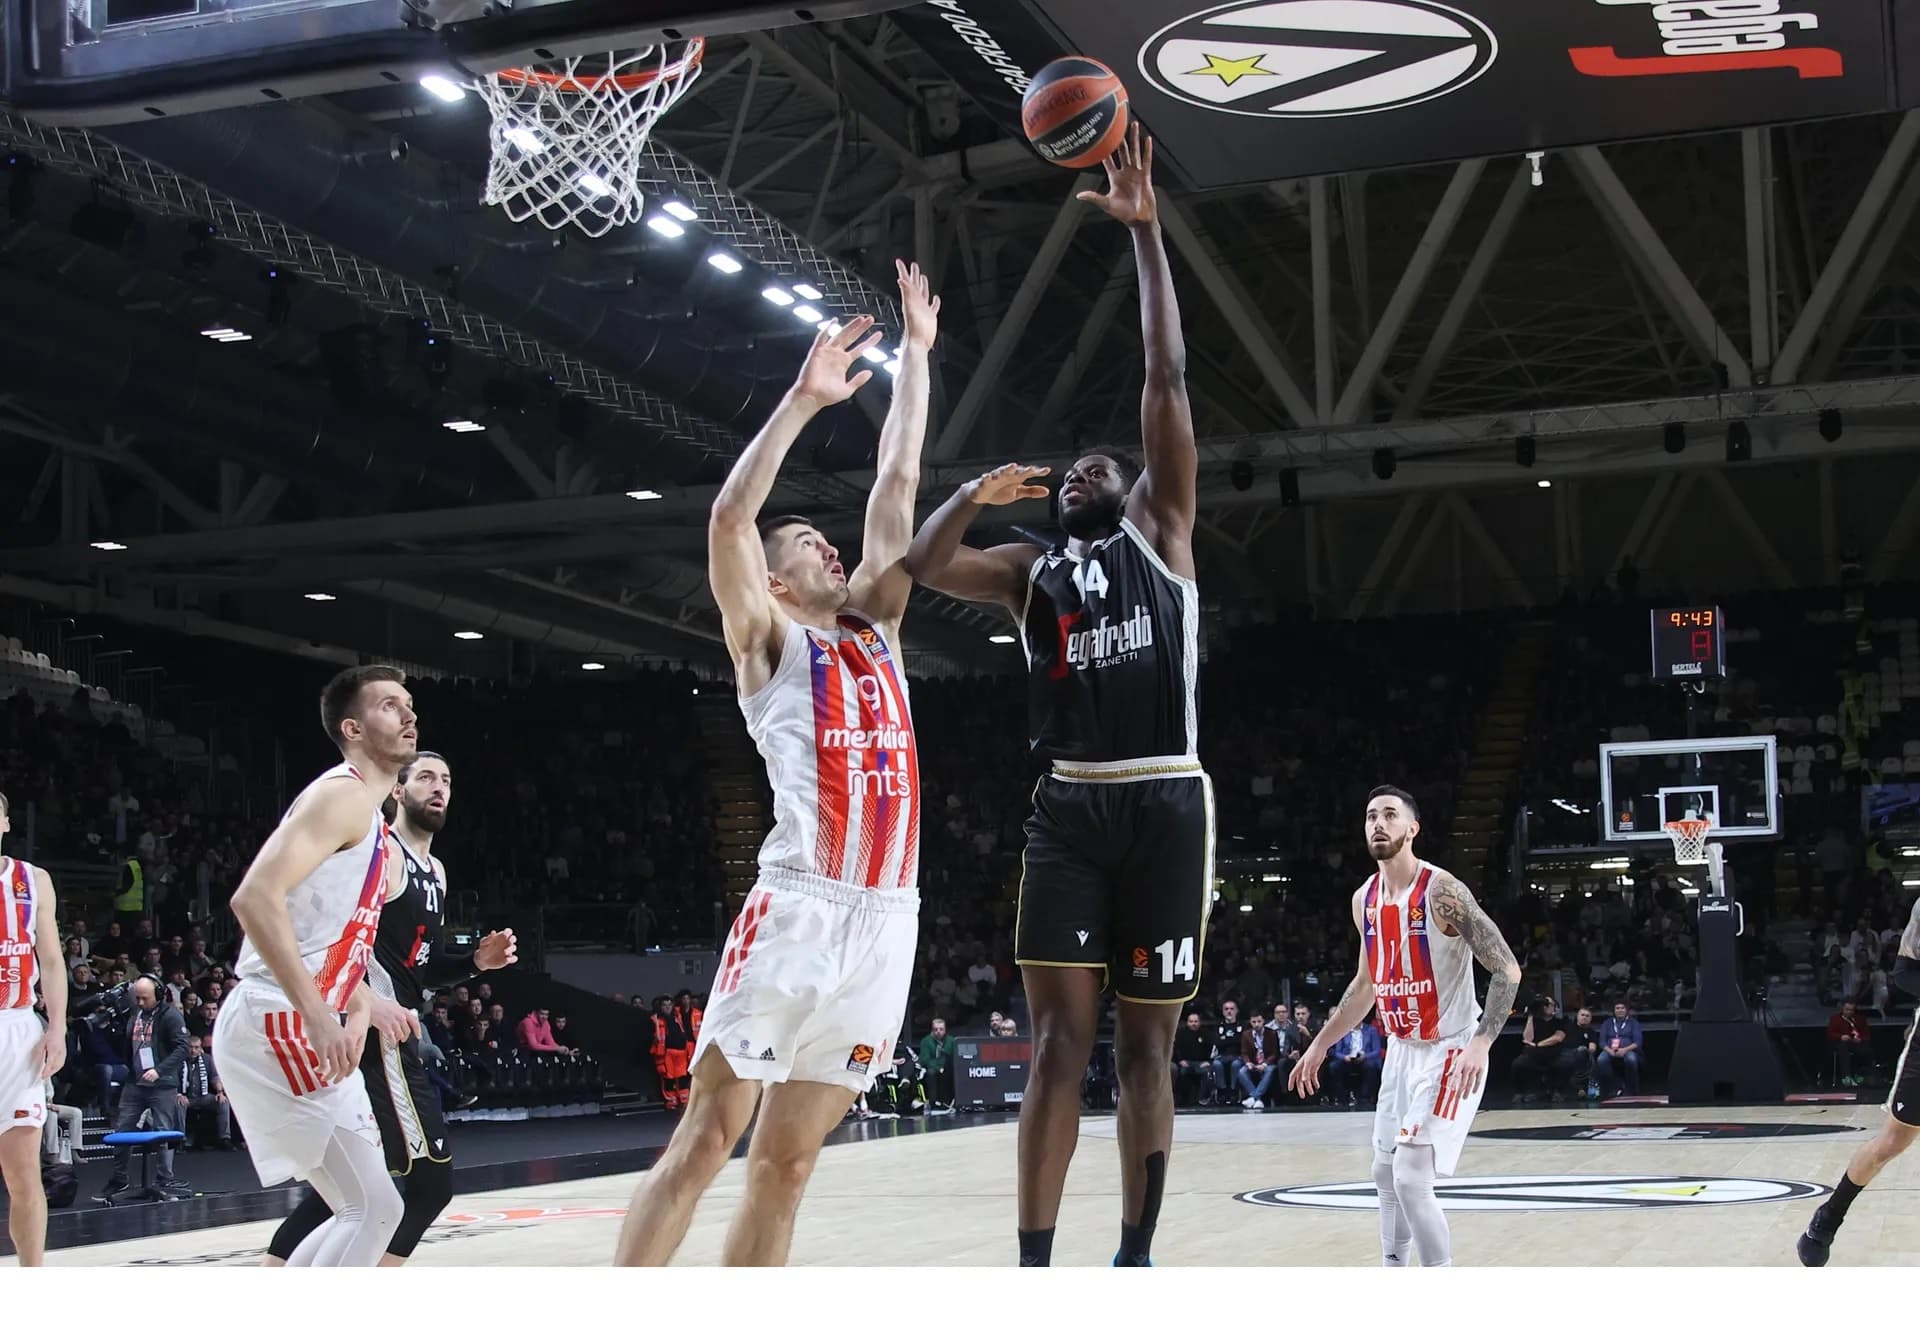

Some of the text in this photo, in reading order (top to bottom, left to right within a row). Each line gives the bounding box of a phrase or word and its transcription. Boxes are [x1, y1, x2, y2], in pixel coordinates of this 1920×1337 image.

[940, 11, 1034, 96] EGAFREDO
[1671, 611, 1713, 627] 9:43
[1095, 651, 1138, 669] ZANETTI
[857, 675, 882, 711] 9
[823, 723, 911, 750] meridia
[848, 765, 911, 798] mts
[1155, 936, 1196, 984] 14
[1380, 1006, 1423, 1029] mts
[968, 1066, 997, 1079] HOME
